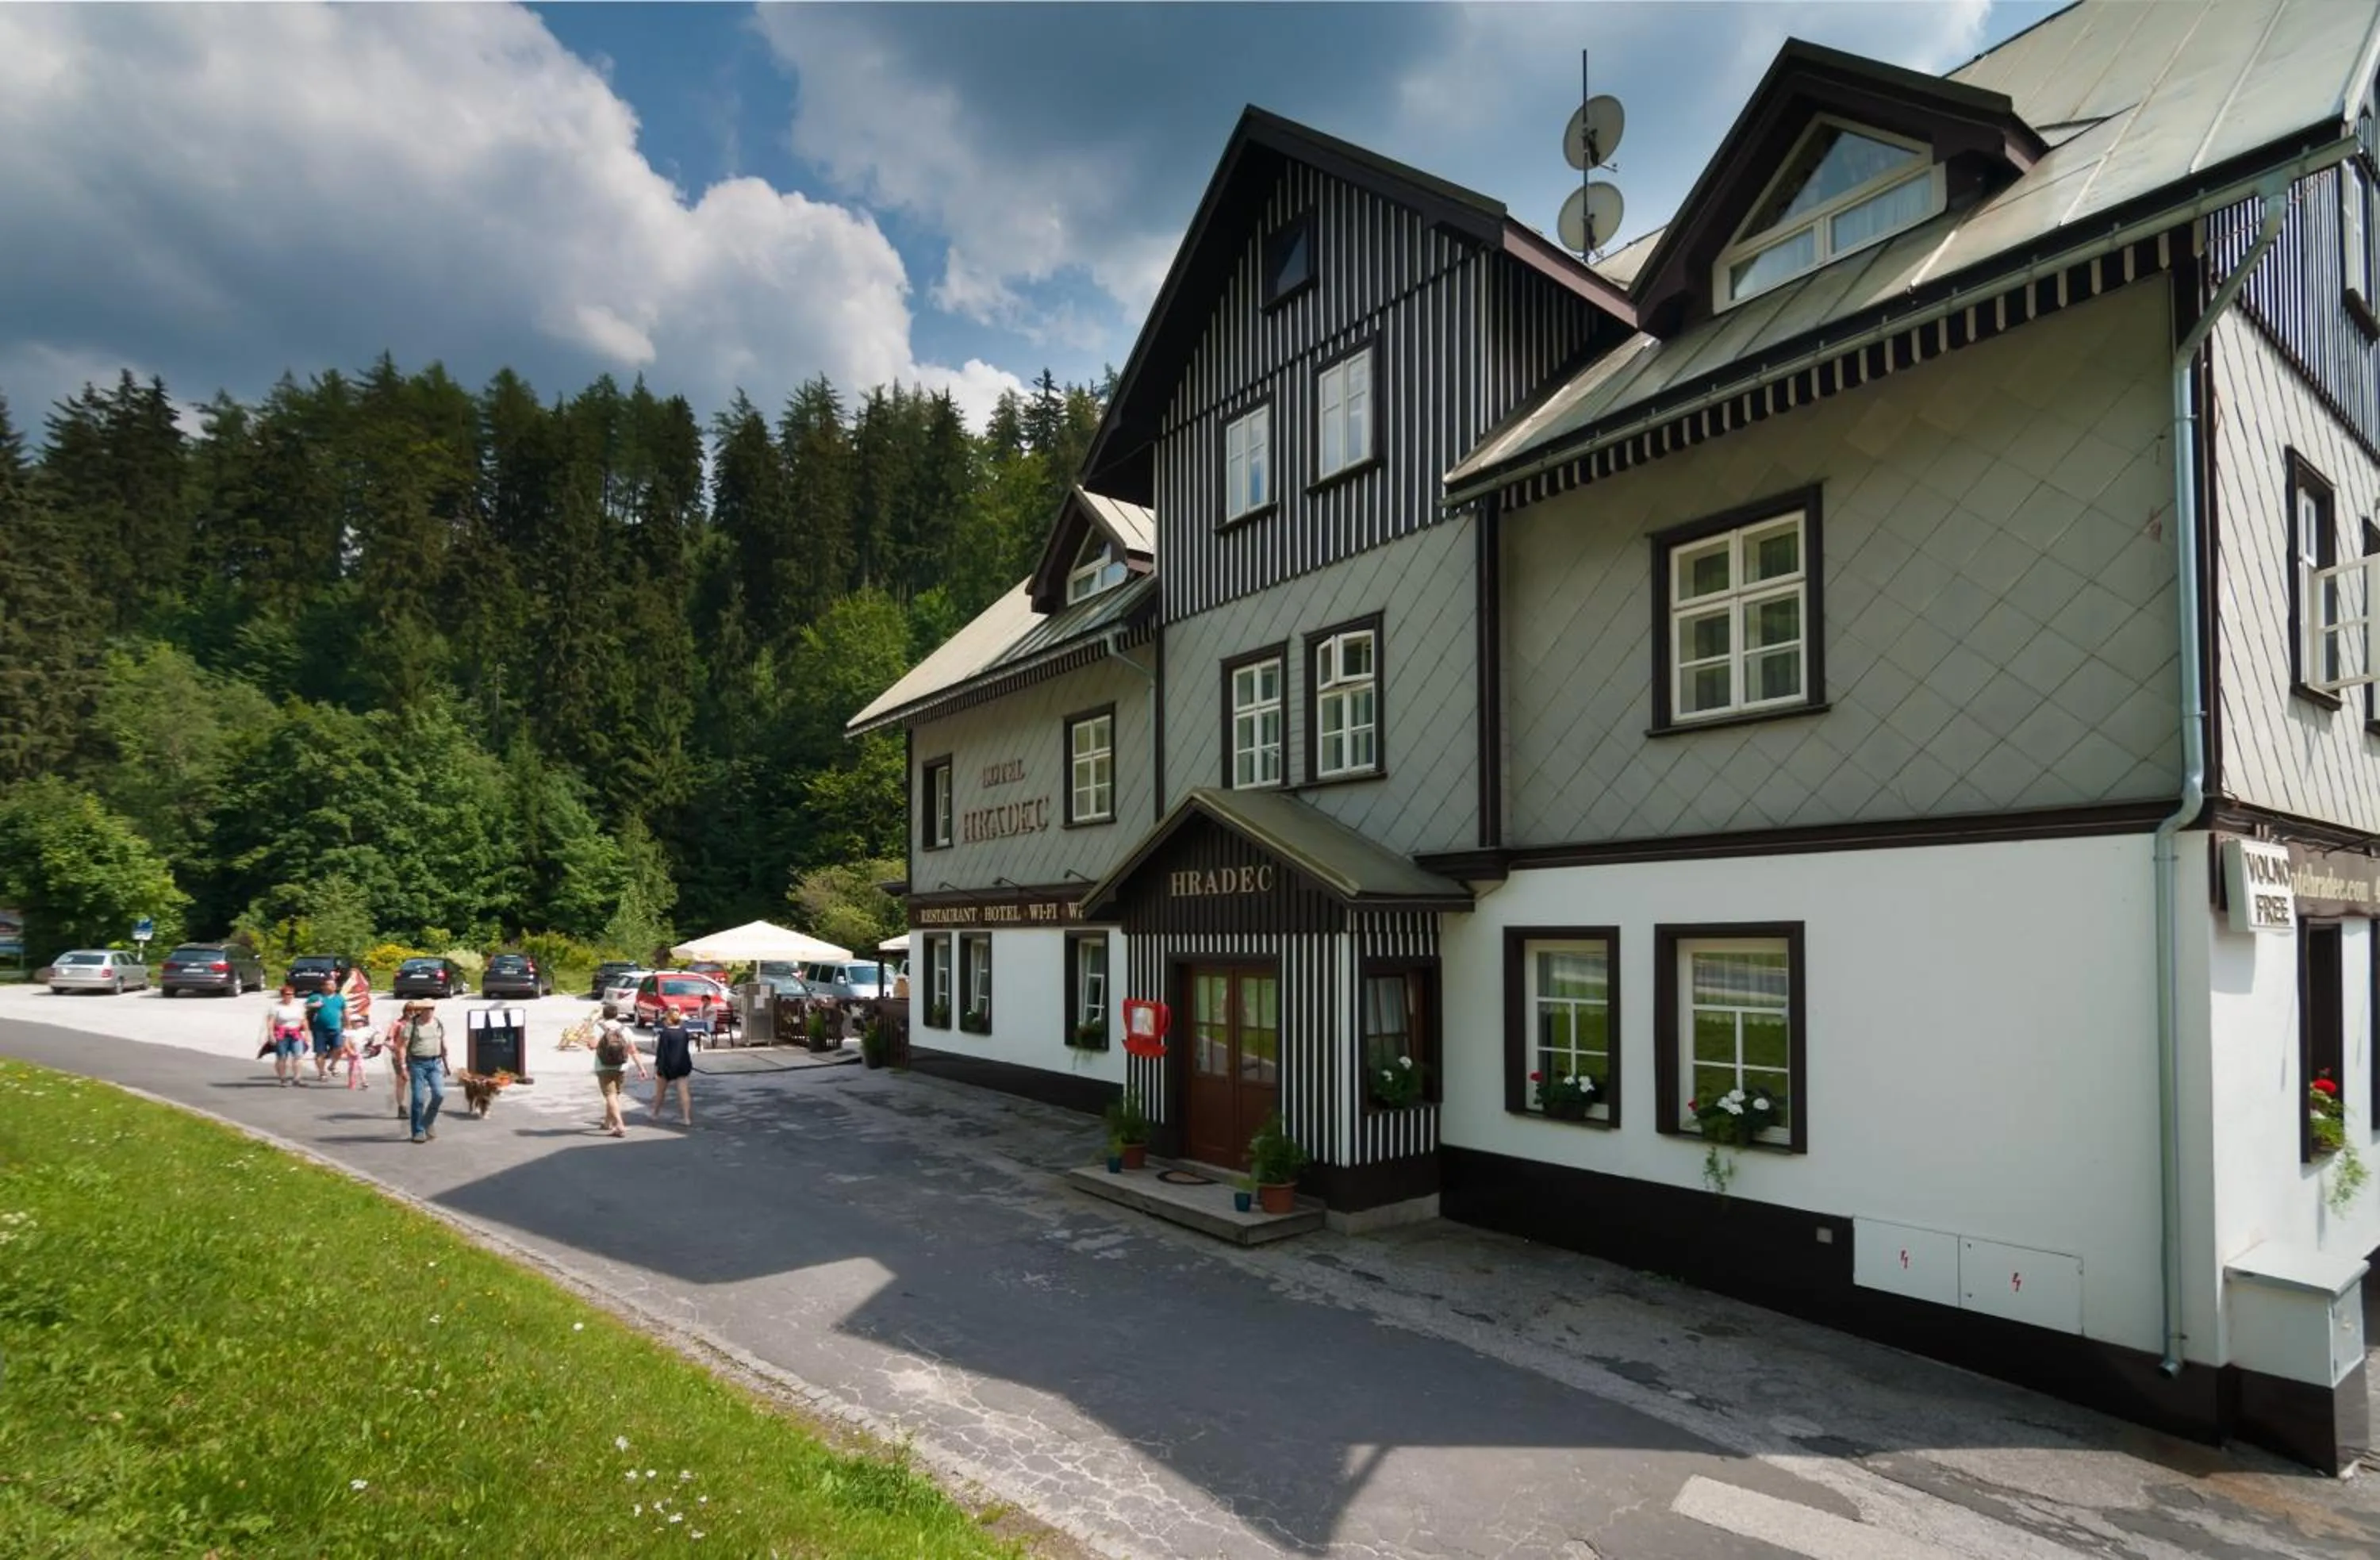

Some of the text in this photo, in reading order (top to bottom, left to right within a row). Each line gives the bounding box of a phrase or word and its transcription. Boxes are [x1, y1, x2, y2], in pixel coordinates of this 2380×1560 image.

[963, 796, 1050, 843] HRADEC
[1170, 866, 1273, 897] HRADEC
[2244, 852, 2290, 887] VOLNO
[2290, 863, 2369, 902] otelhradec.com
[920, 907, 978, 924] RESTAURANT
[984, 905, 1021, 922] HOTEL
[1029, 902, 1058, 920] WI-FI
[2255, 894, 2290, 925] FREE
